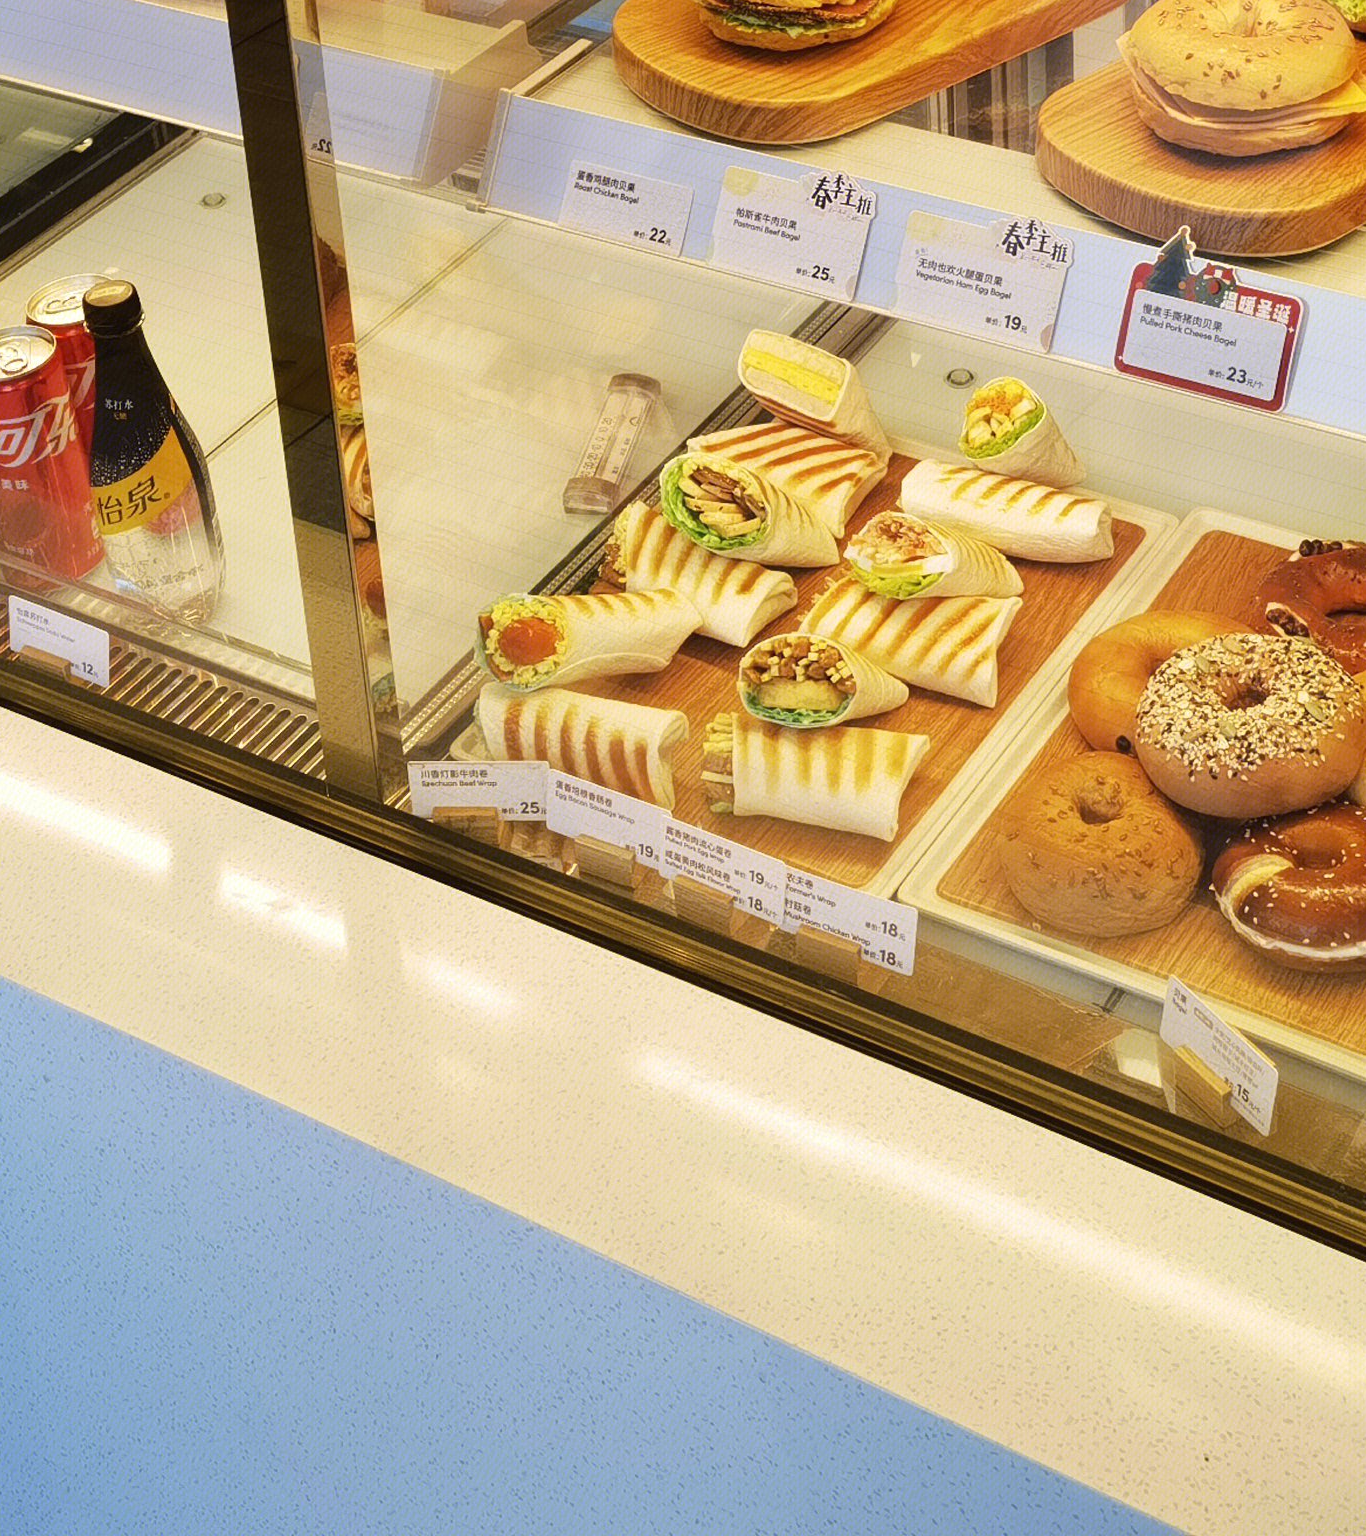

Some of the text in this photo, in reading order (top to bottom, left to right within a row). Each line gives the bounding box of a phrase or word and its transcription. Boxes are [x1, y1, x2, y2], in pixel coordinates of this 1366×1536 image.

[593, 187, 619, 200] Chicken
[620, 194, 639, 204] Bagel
[811, 173, 873, 216] 春季主推
[733, 219, 800, 242] Pastrami Beef Bagel
[1002, 219, 1068, 264] 春季主推
[915, 269, 1012, 300] Vegetarian Ham Egg Bagel
[917, 257, 1003, 287] 无肉也欢火腿蛋贝果
[1142, 303, 1222, 333] 慢煮手撕猪肉贝果
[1220, 290, 1292, 325] 温暖圣诞
[1139, 315, 1237, 347] Pulled Pork Cheese Bagel
[104, 397, 134, 410] 苏打水
[97, 475, 162, 526] 怡泉
[477, 780, 498, 788] Wrap
[554, 790, 567, 801] Egg
[568, 794, 588, 807] Bacon
[618, 811, 635, 824] Wrap
[786, 872, 813, 890] 农夫卷
[817, 894, 836, 907] Wrap
[784, 910, 871, 946] Mushroom Chicken Wrap
